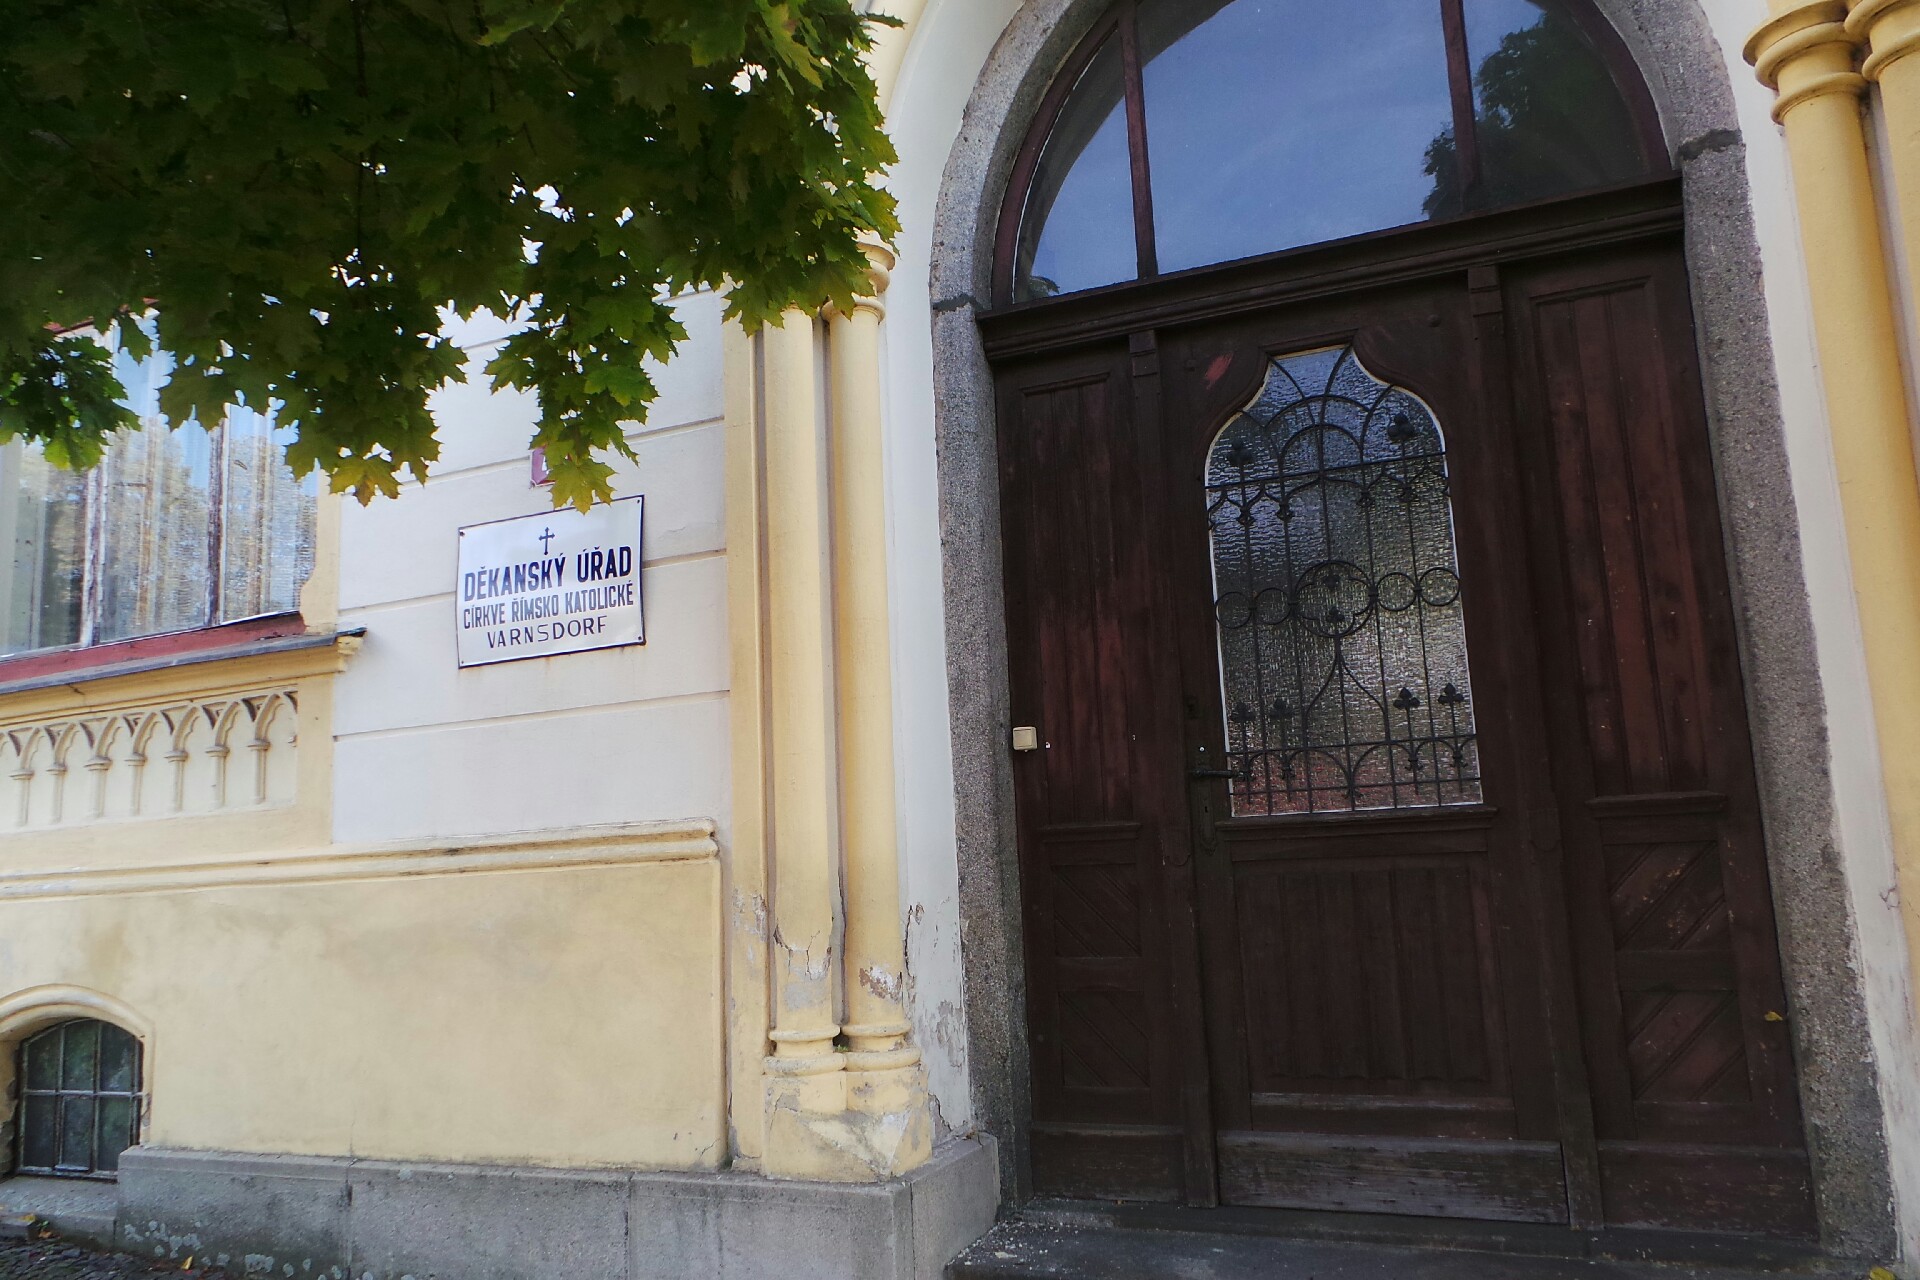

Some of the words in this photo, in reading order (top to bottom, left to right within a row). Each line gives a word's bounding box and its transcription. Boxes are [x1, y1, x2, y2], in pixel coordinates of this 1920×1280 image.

[464, 553, 566, 601] DĚKANSKÝ
[577, 546, 632, 583] ÚŘAD
[463, 602, 505, 629] CÍRKVE
[511, 594, 559, 623] ŘÍMSKO
[565, 580, 634, 615] KATOLICKÉ
[487, 615, 608, 648] VARNSDORF
